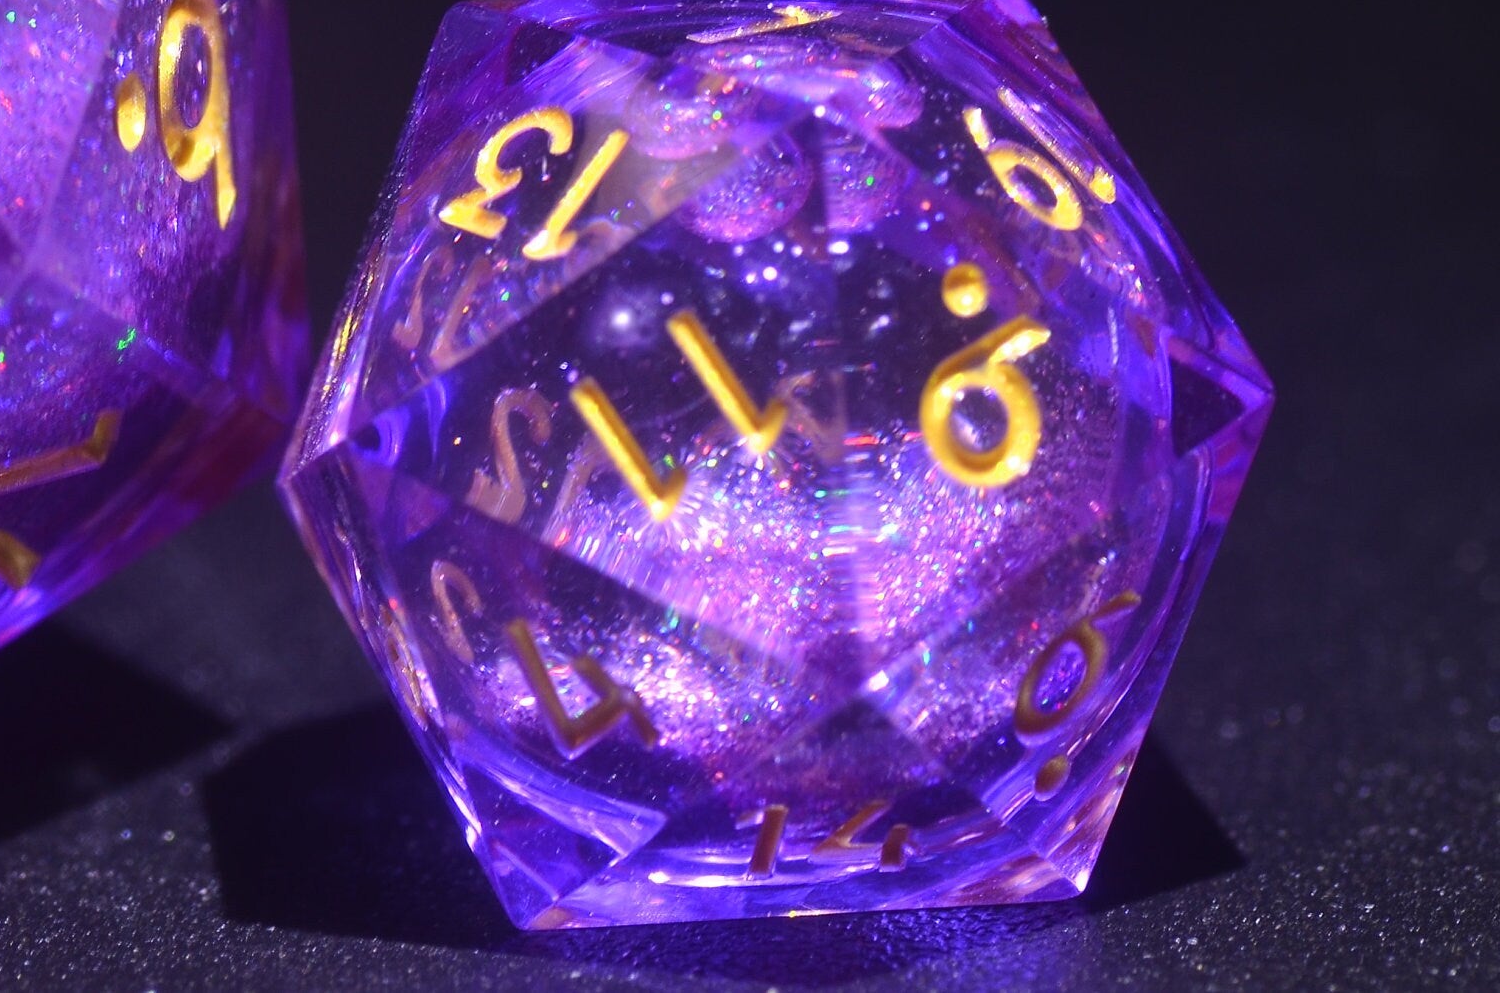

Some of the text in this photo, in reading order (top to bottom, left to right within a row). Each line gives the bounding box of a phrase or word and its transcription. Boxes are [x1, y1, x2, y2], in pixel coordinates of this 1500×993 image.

[439, 107, 629, 260] 13
[570, 310, 788, 522] 11
[506, 617, 658, 760] 4
